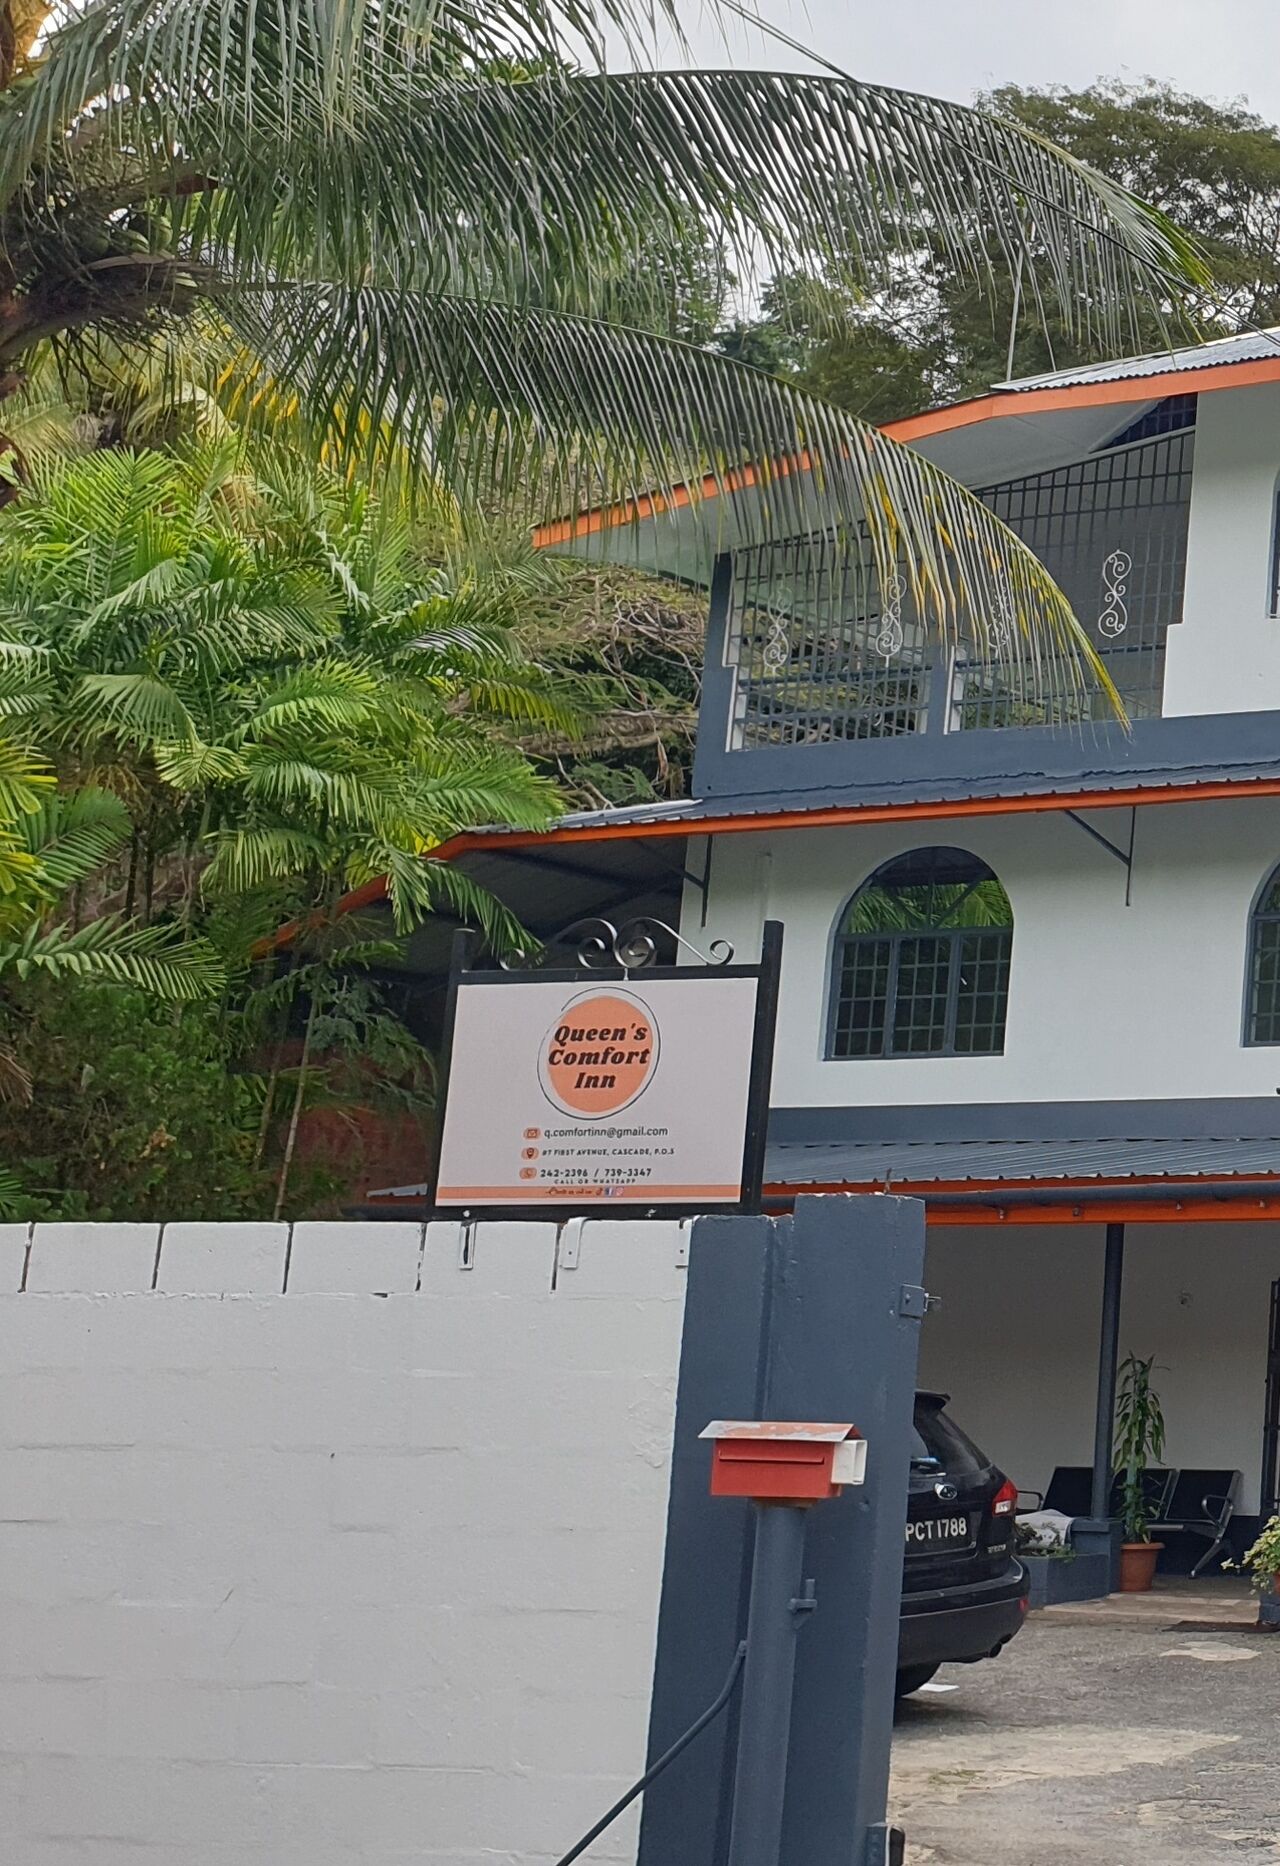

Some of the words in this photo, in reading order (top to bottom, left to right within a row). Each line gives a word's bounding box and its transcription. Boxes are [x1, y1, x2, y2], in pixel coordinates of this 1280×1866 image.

[554, 1022, 648, 1047] Queen's
[548, 1046, 650, 1066] Comfort
[574, 1072, 616, 1089] Inn
[544, 1126, 668, 1139] q.comfortinn@gmail.com
[540, 1169, 588, 1178] 242-2396
[605, 1168, 652, 1177] 739-3347
